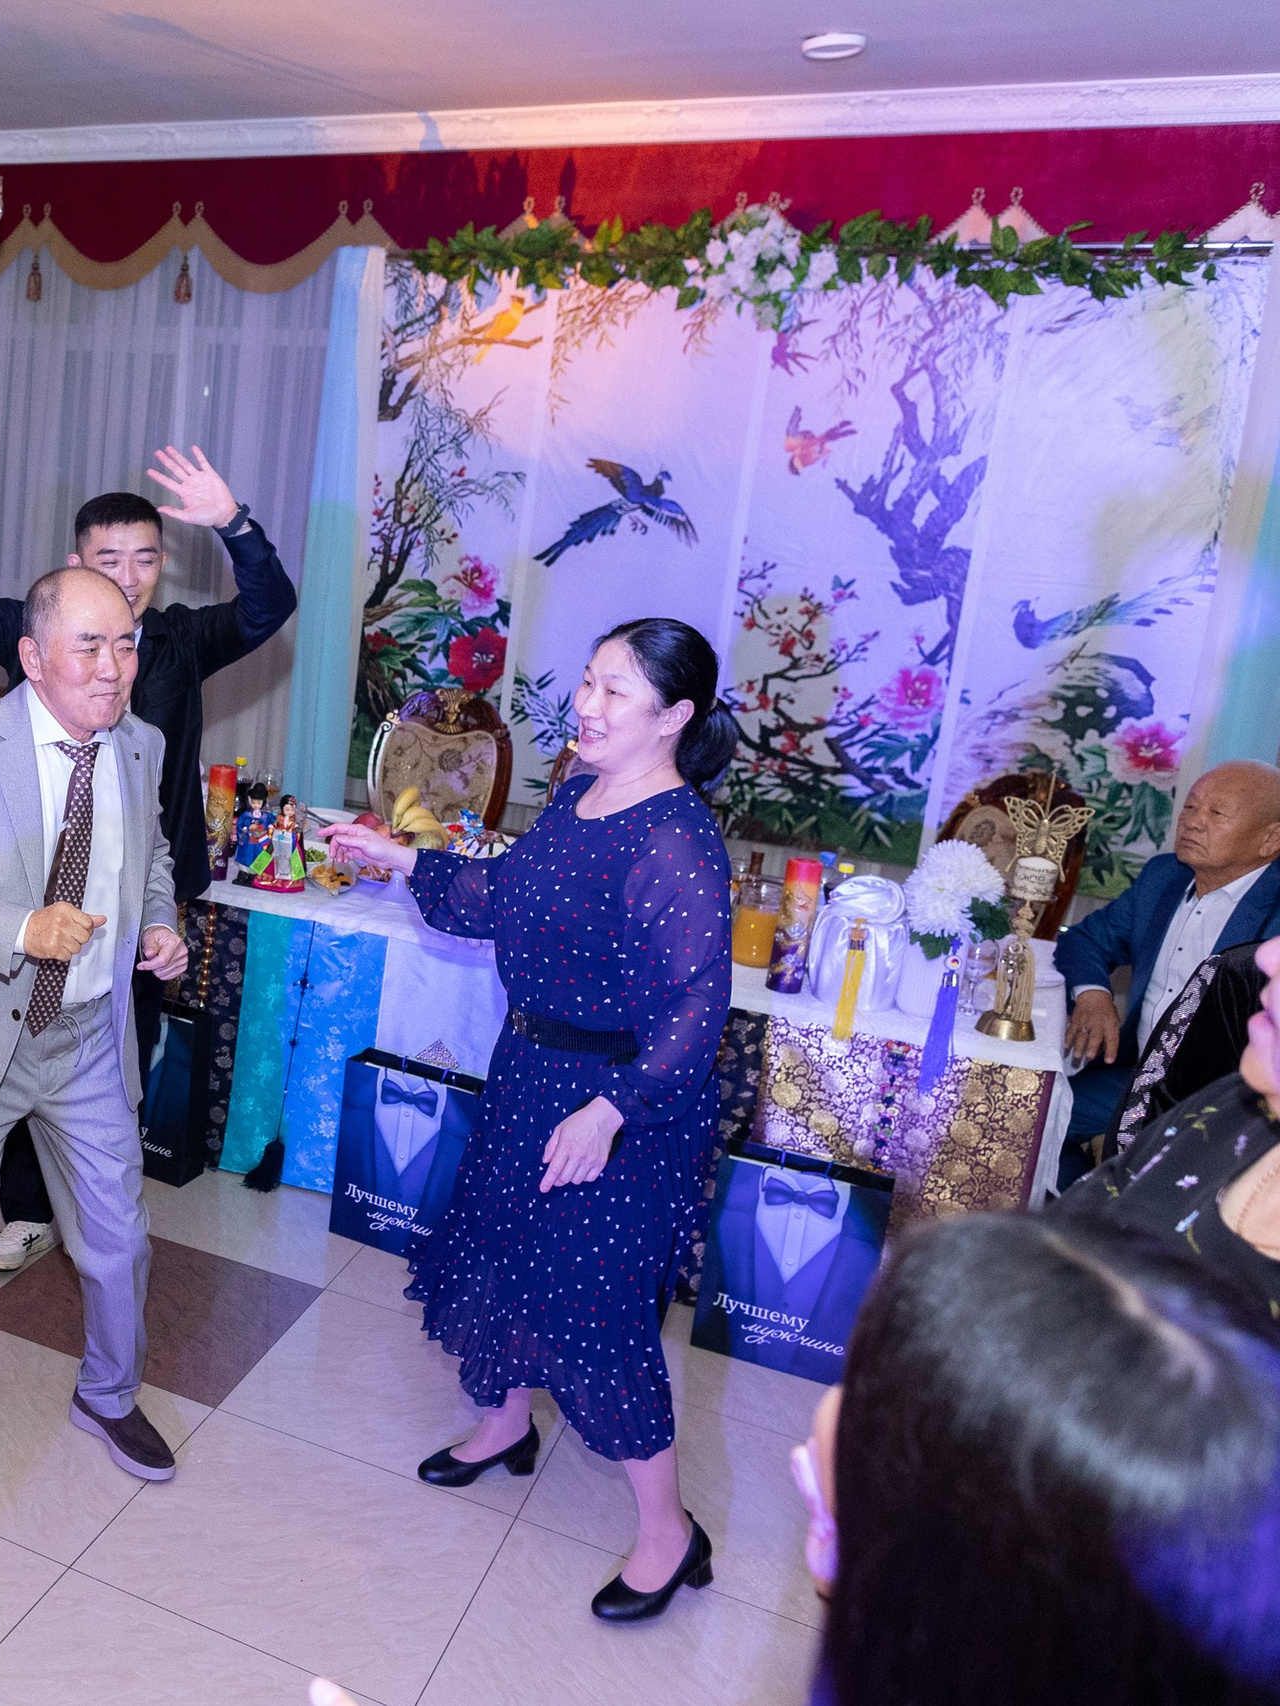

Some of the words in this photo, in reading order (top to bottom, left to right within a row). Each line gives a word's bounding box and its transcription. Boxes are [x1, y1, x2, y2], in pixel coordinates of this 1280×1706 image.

[140, 1141, 173, 1158] чине
[344, 1182, 419, 1221] Лучшему
[366, 1211, 433, 1237] мужчи
[712, 1291, 810, 1333] Лучшему
[740, 1323, 846, 1356] мужчине
